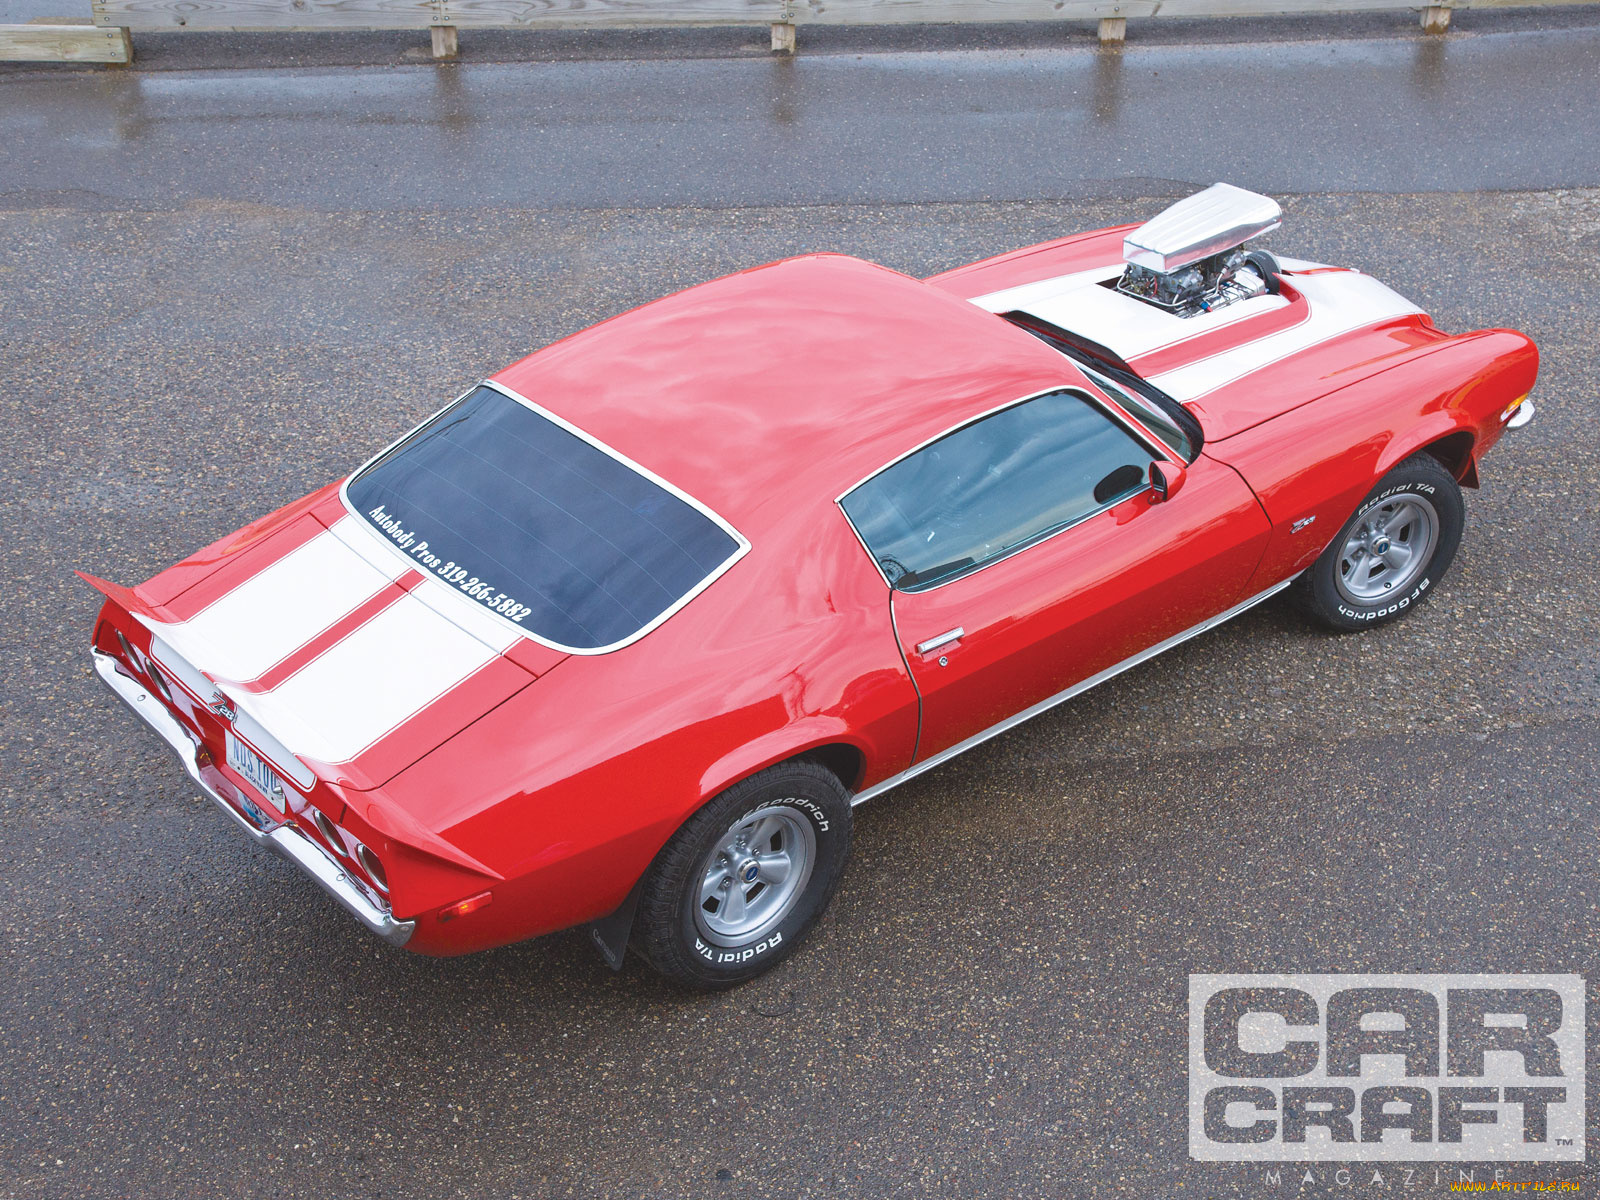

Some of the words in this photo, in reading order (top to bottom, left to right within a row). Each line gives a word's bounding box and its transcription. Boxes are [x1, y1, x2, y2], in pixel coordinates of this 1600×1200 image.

[1358, 483, 1411, 516] Radial
[1416, 483, 1436, 495] T/A
[368, 505, 415, 549] Autobody
[410, 541, 441, 568] Pros
[437, 561, 532, 622] 319-266-5882
[695, 938, 713, 960] T/A
[718, 931, 783, 963] Radial
